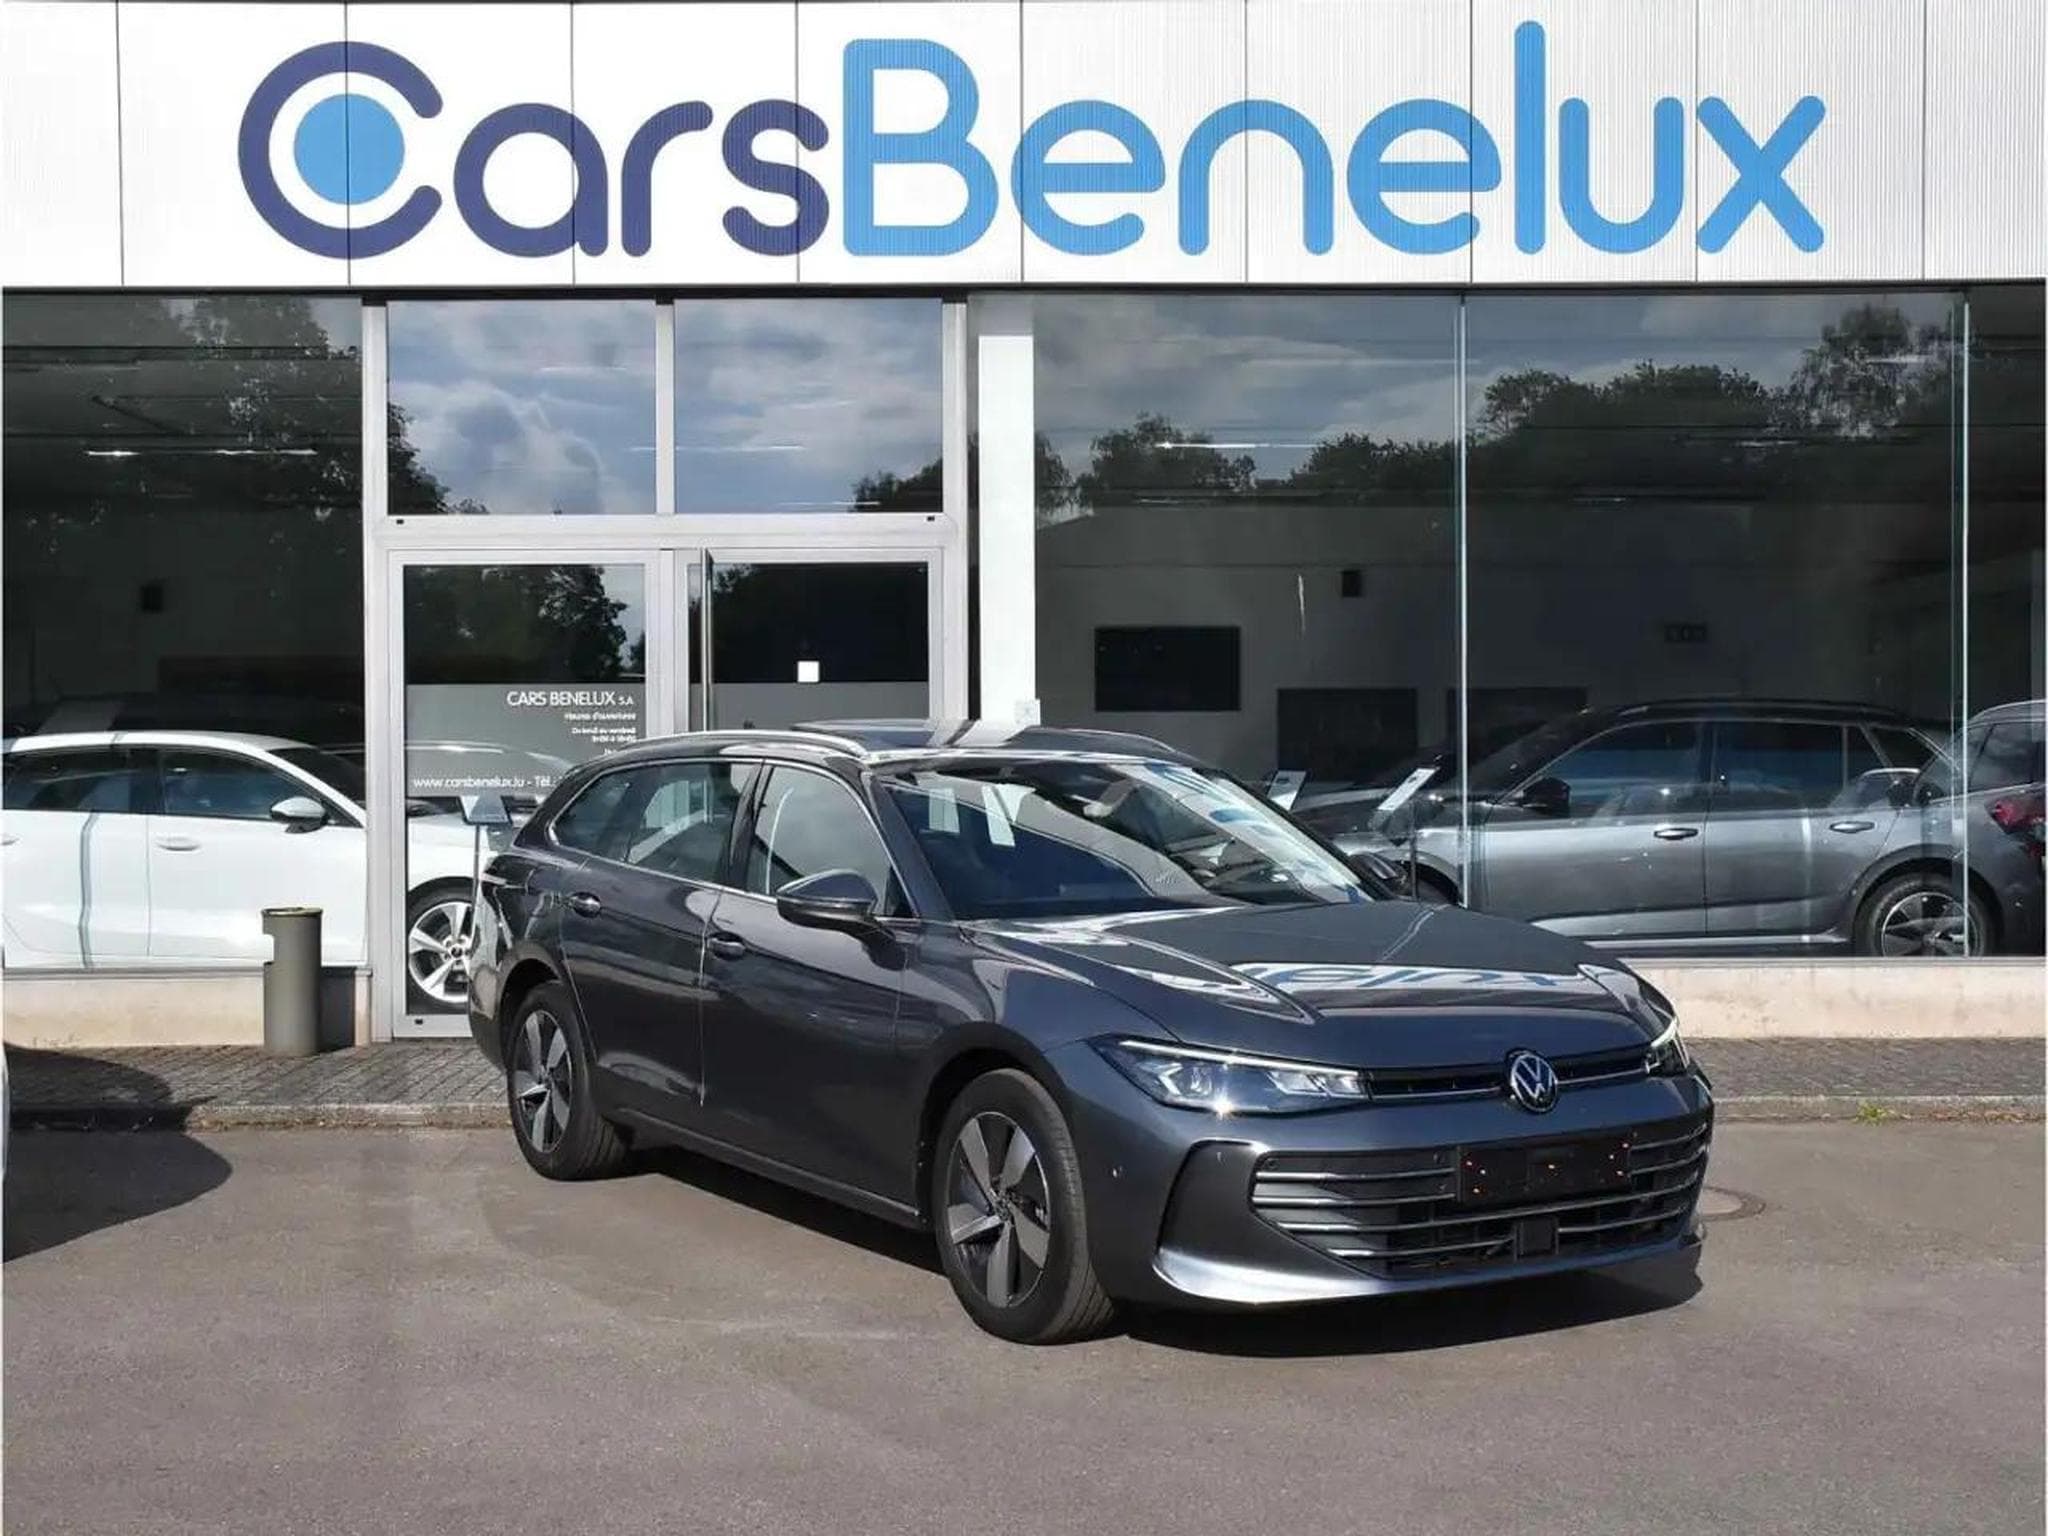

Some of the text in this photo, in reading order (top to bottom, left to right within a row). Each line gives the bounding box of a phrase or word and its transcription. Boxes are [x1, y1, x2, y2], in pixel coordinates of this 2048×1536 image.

[507, 691, 547, 706] CARS
[550, 691, 617, 706] BENELUX
[413, 775, 525, 788] www.carsbenelux.lu
